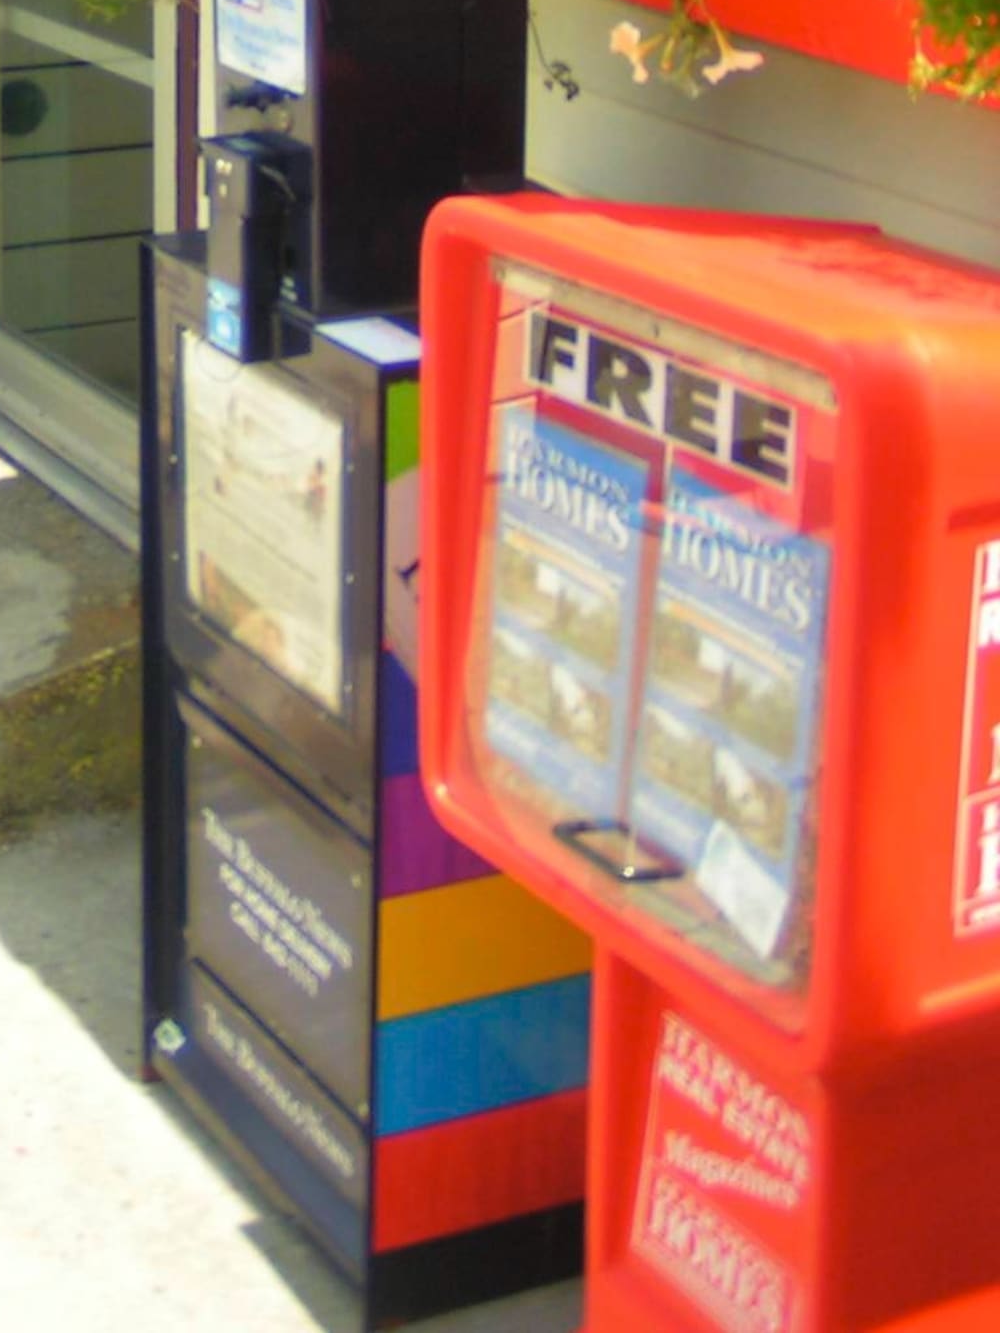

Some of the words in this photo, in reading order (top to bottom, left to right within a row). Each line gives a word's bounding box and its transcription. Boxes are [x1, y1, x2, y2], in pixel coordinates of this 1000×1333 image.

[529, 311, 794, 486] FREE
[505, 449, 629, 552] HOMES
[506, 423, 629, 508] HARMON
[661, 516, 813, 631] HOMES
[659, 1052, 719, 1116] REAL
[721, 1098, 809, 1184] ESTATE
[663, 1012, 809, 1146] HARMON
